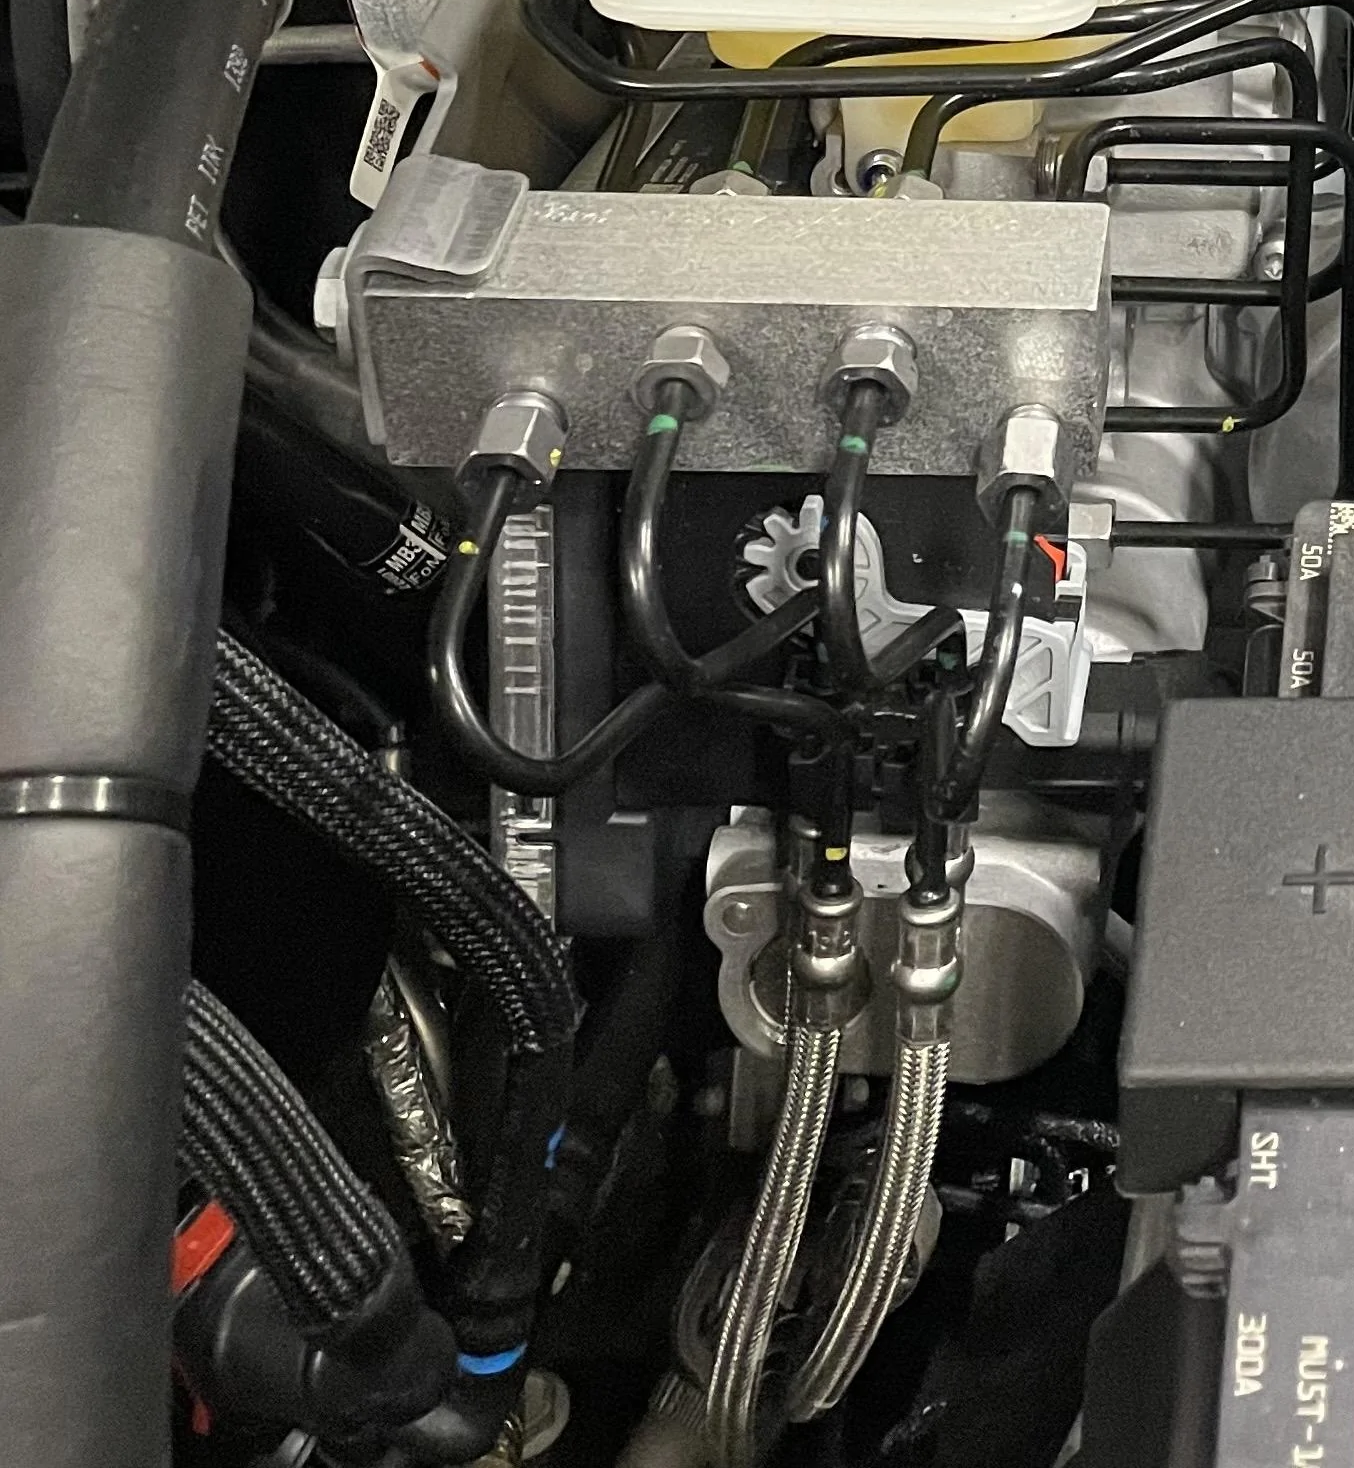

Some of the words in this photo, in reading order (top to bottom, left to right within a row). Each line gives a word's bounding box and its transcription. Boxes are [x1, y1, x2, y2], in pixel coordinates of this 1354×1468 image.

[1300, 543, 1323, 581] 50A
[1290, 648, 1314, 689] 50A
[1251, 1132, 1279, 1189] SHT
[1234, 1312, 1267, 1397] 300A
